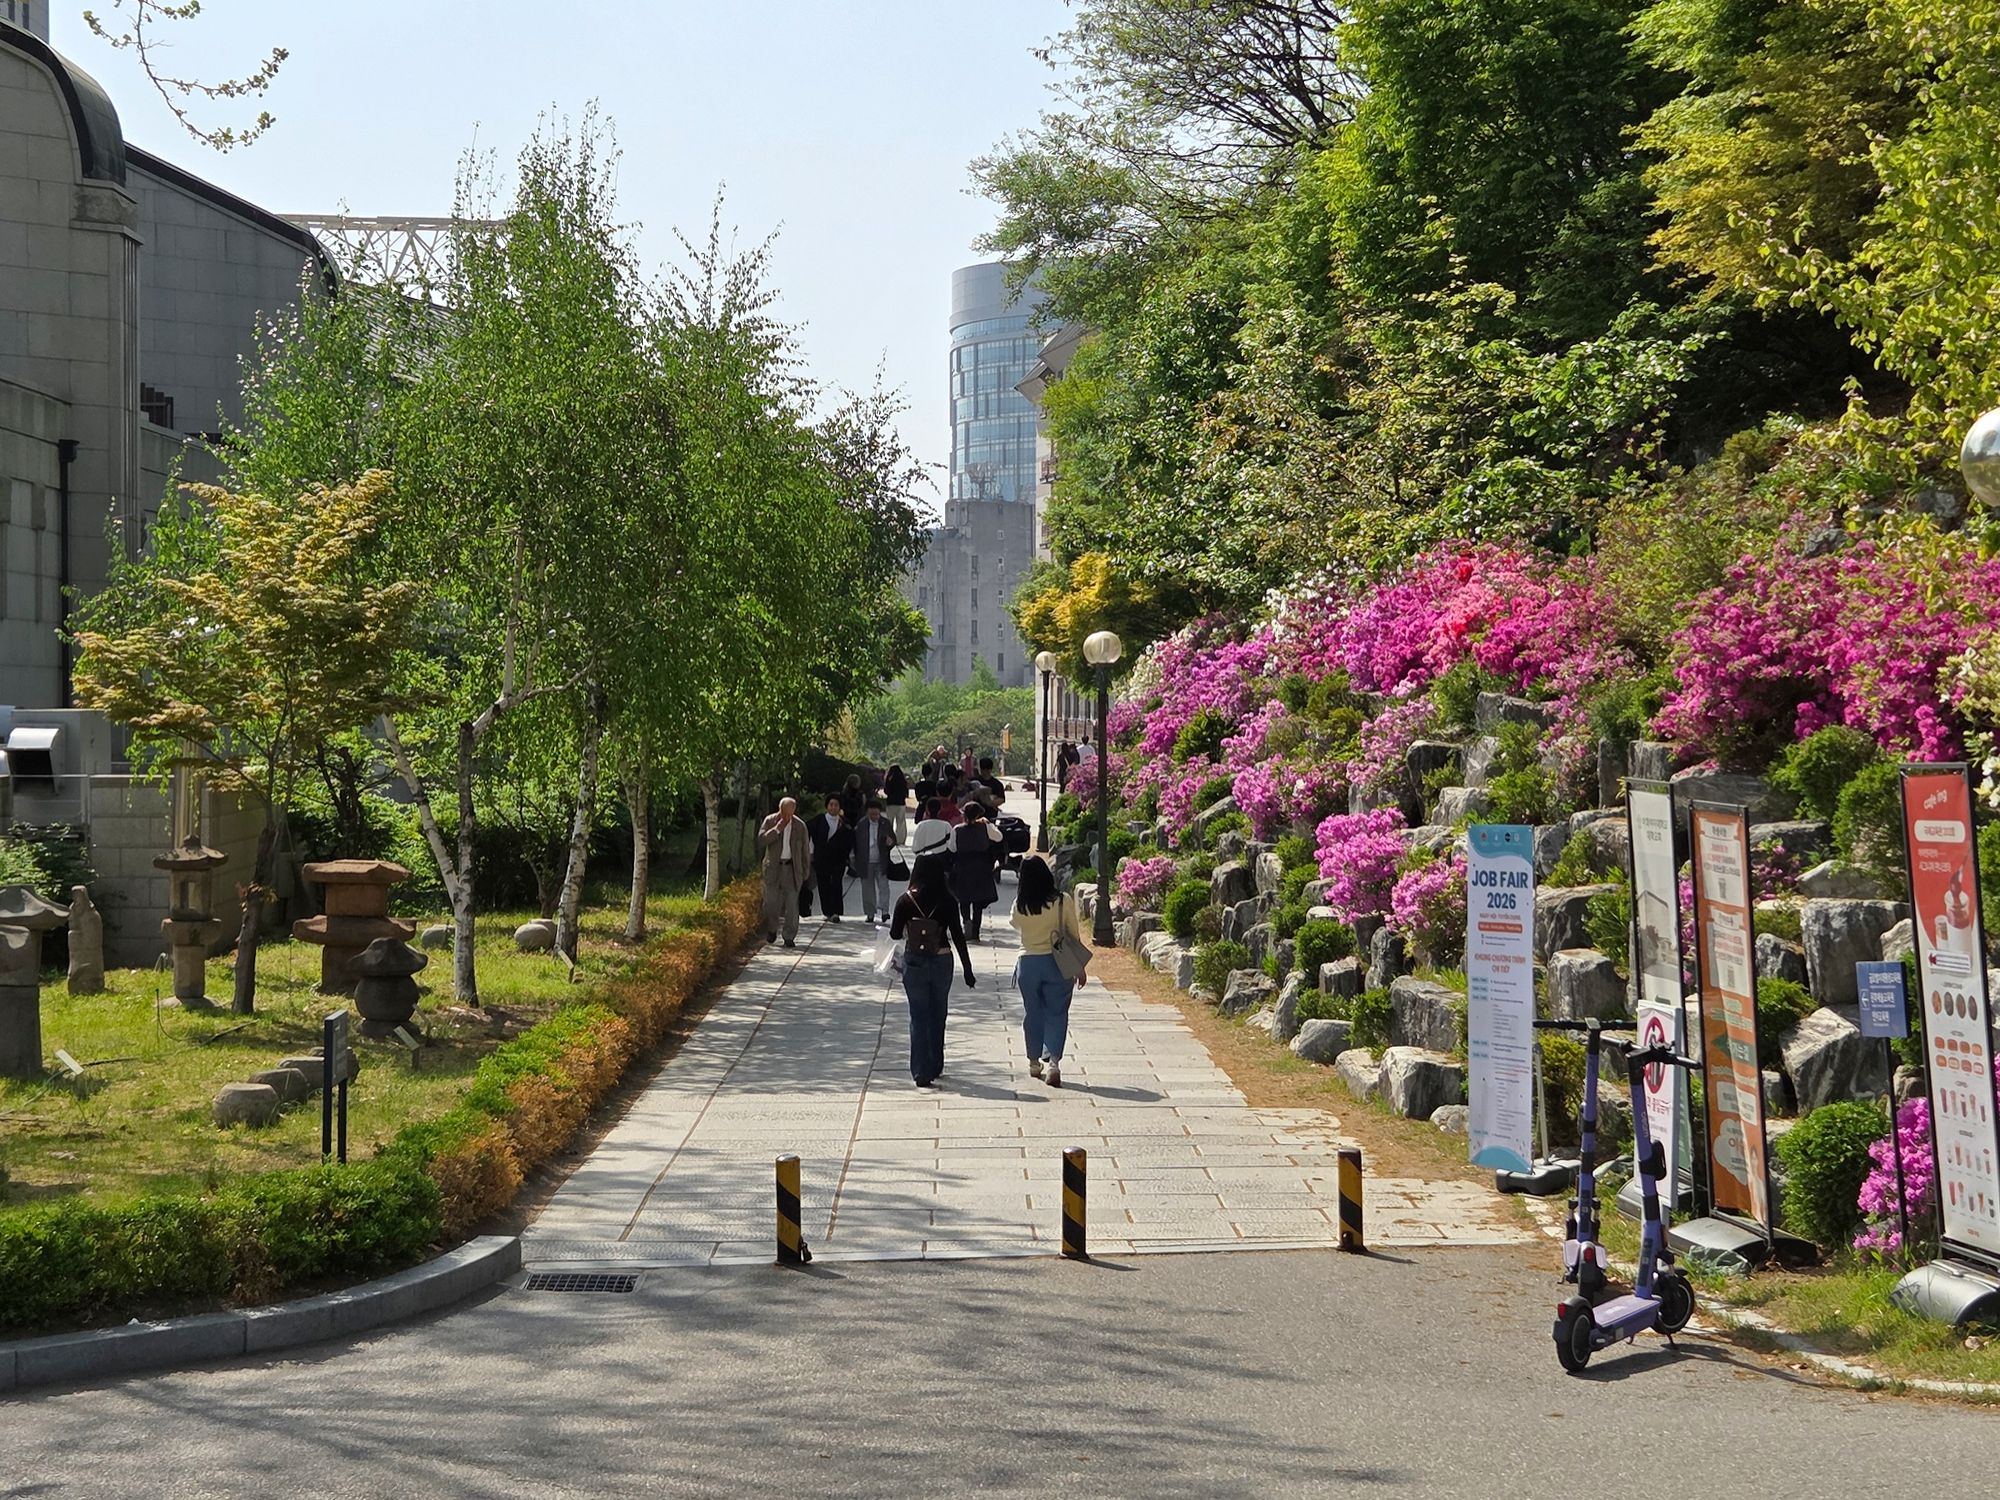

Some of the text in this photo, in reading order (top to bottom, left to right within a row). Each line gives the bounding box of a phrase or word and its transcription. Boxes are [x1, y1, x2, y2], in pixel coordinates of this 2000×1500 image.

[1472, 869, 1529, 889] JOB FAIR
[1487, 892, 1517, 909] 2026
